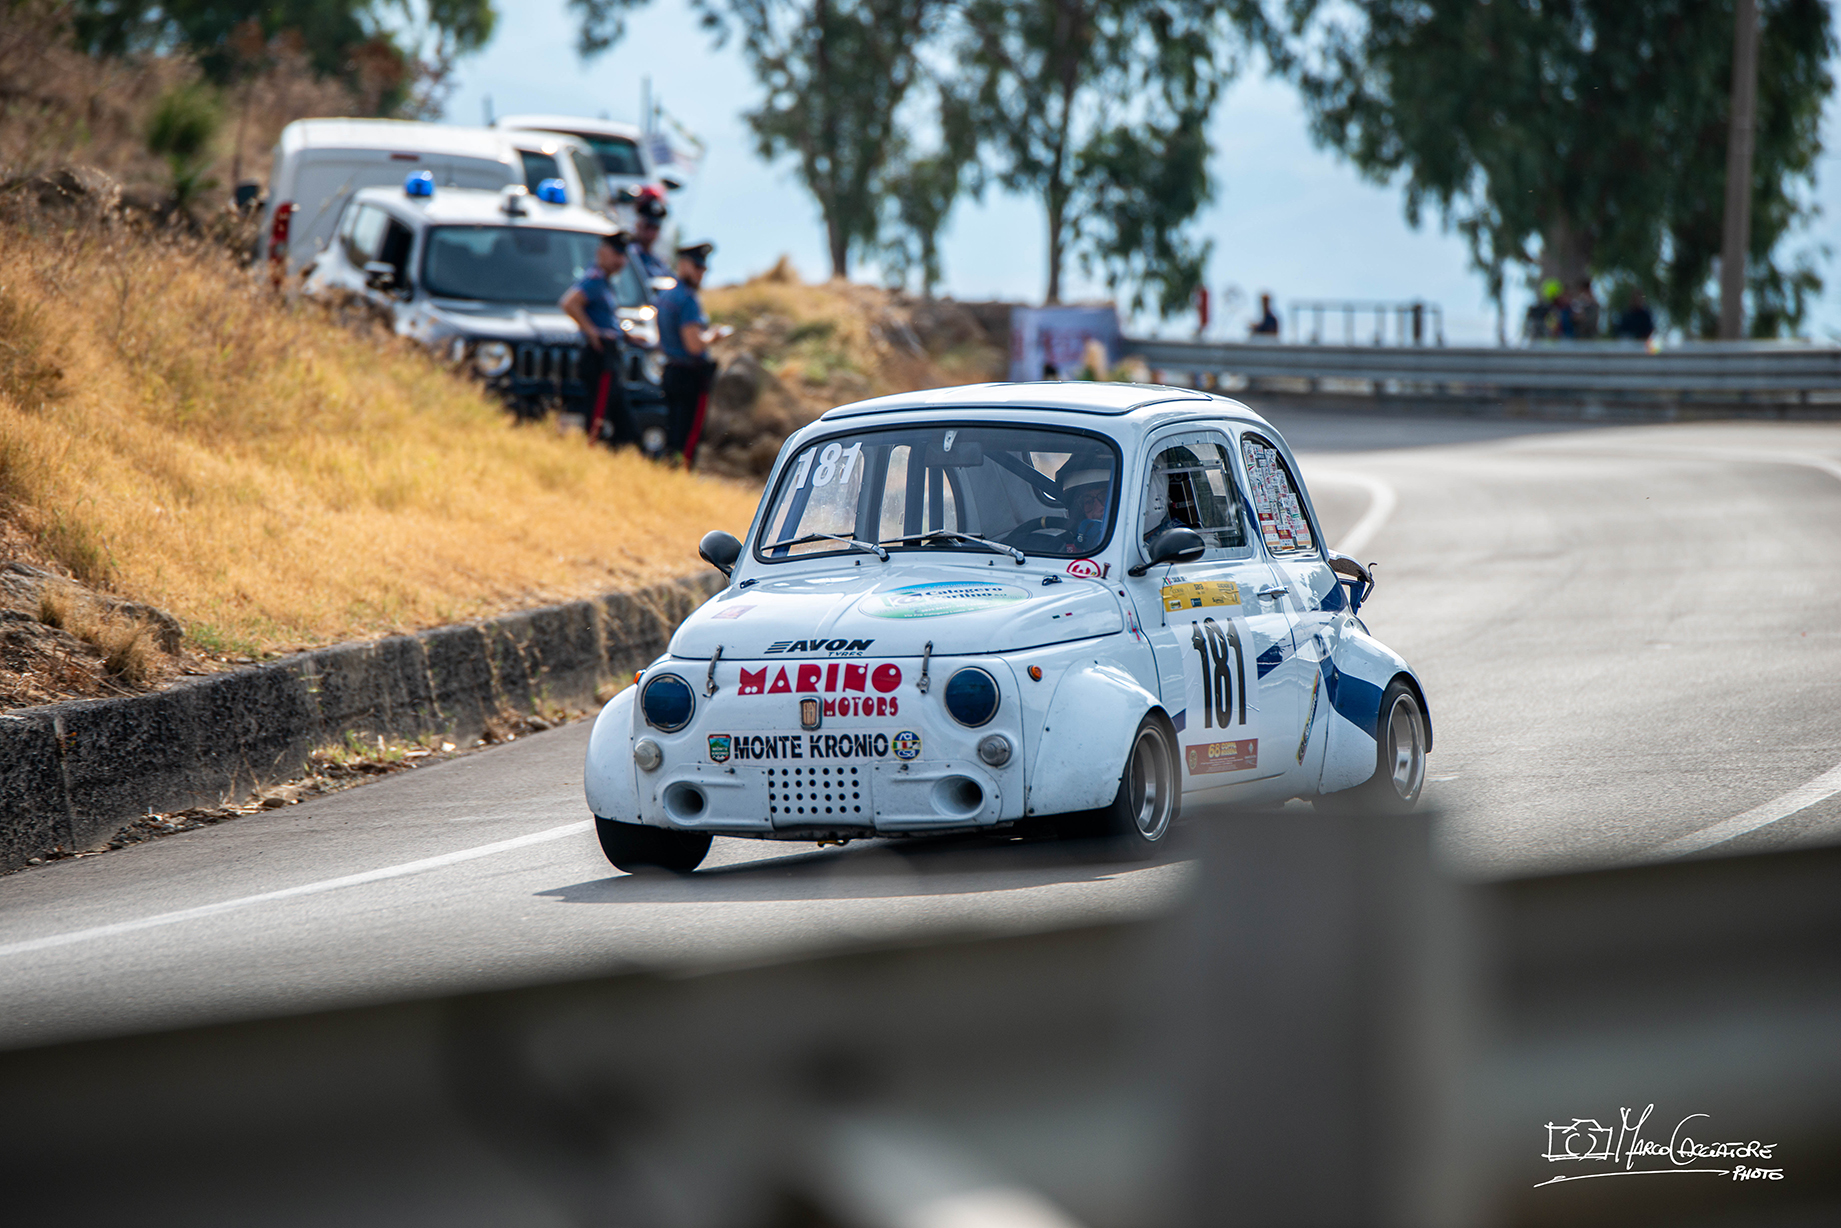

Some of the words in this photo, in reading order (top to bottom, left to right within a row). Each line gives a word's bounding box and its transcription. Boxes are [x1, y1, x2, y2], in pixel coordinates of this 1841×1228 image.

[795, 441, 863, 490] 181
[785, 638, 876, 653] AVON
[737, 663, 903, 697] MARINO
[1191, 616, 1246, 729] 181
[823, 696, 899, 718] MOTORS
[733, 735, 803, 759] MONTE
[1208, 742, 1221, 759] 68
